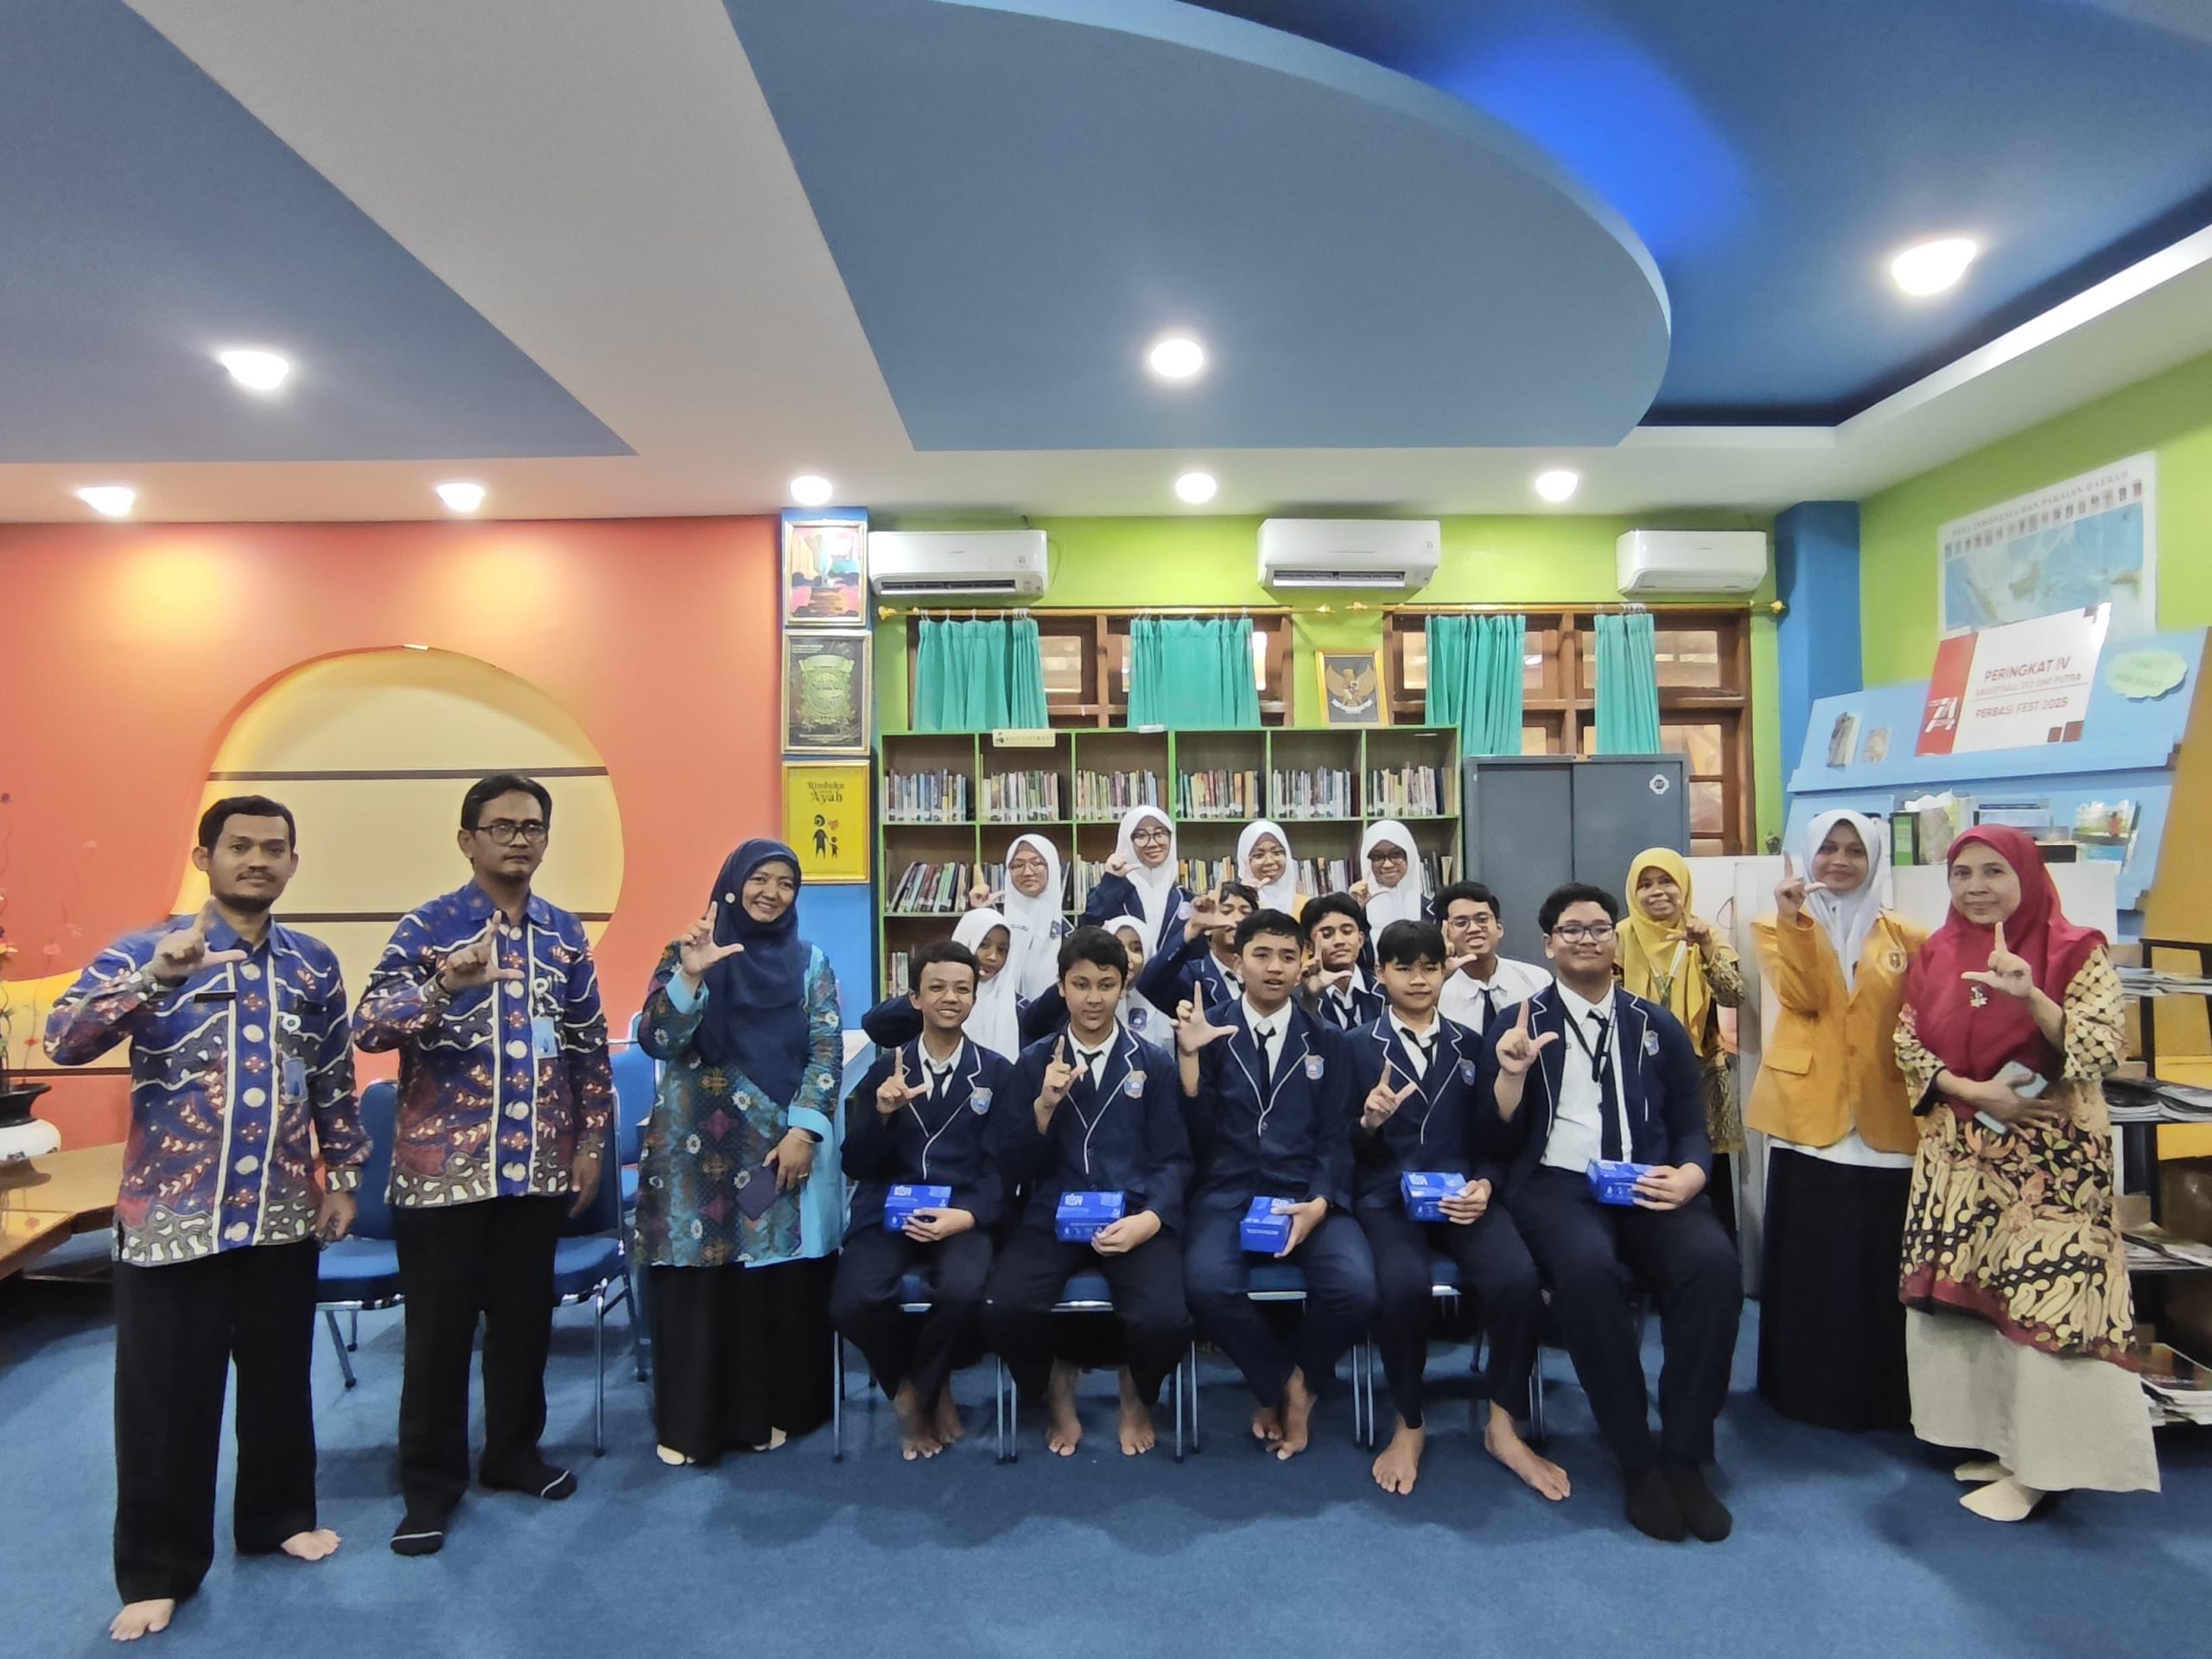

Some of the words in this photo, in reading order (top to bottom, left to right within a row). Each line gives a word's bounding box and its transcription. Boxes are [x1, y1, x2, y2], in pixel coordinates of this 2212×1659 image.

[1973, 508, 2018, 530] INDONESIA
[2021, 502, 2038, 513] DAN
[2042, 486, 2083, 506] PAKAIAN
[2087, 471, 2128, 491] DAERAH
[1984, 659, 2053, 682] PERINGKAT
[2056, 657, 2072, 671] IV
[2055, 673, 2082, 684] PUTRA
[1975, 705, 2013, 718] PERBASI
[2017, 701, 2040, 713] FEST
[2042, 696, 2069, 709] 2025
[809, 790, 843, 804] Ayah
